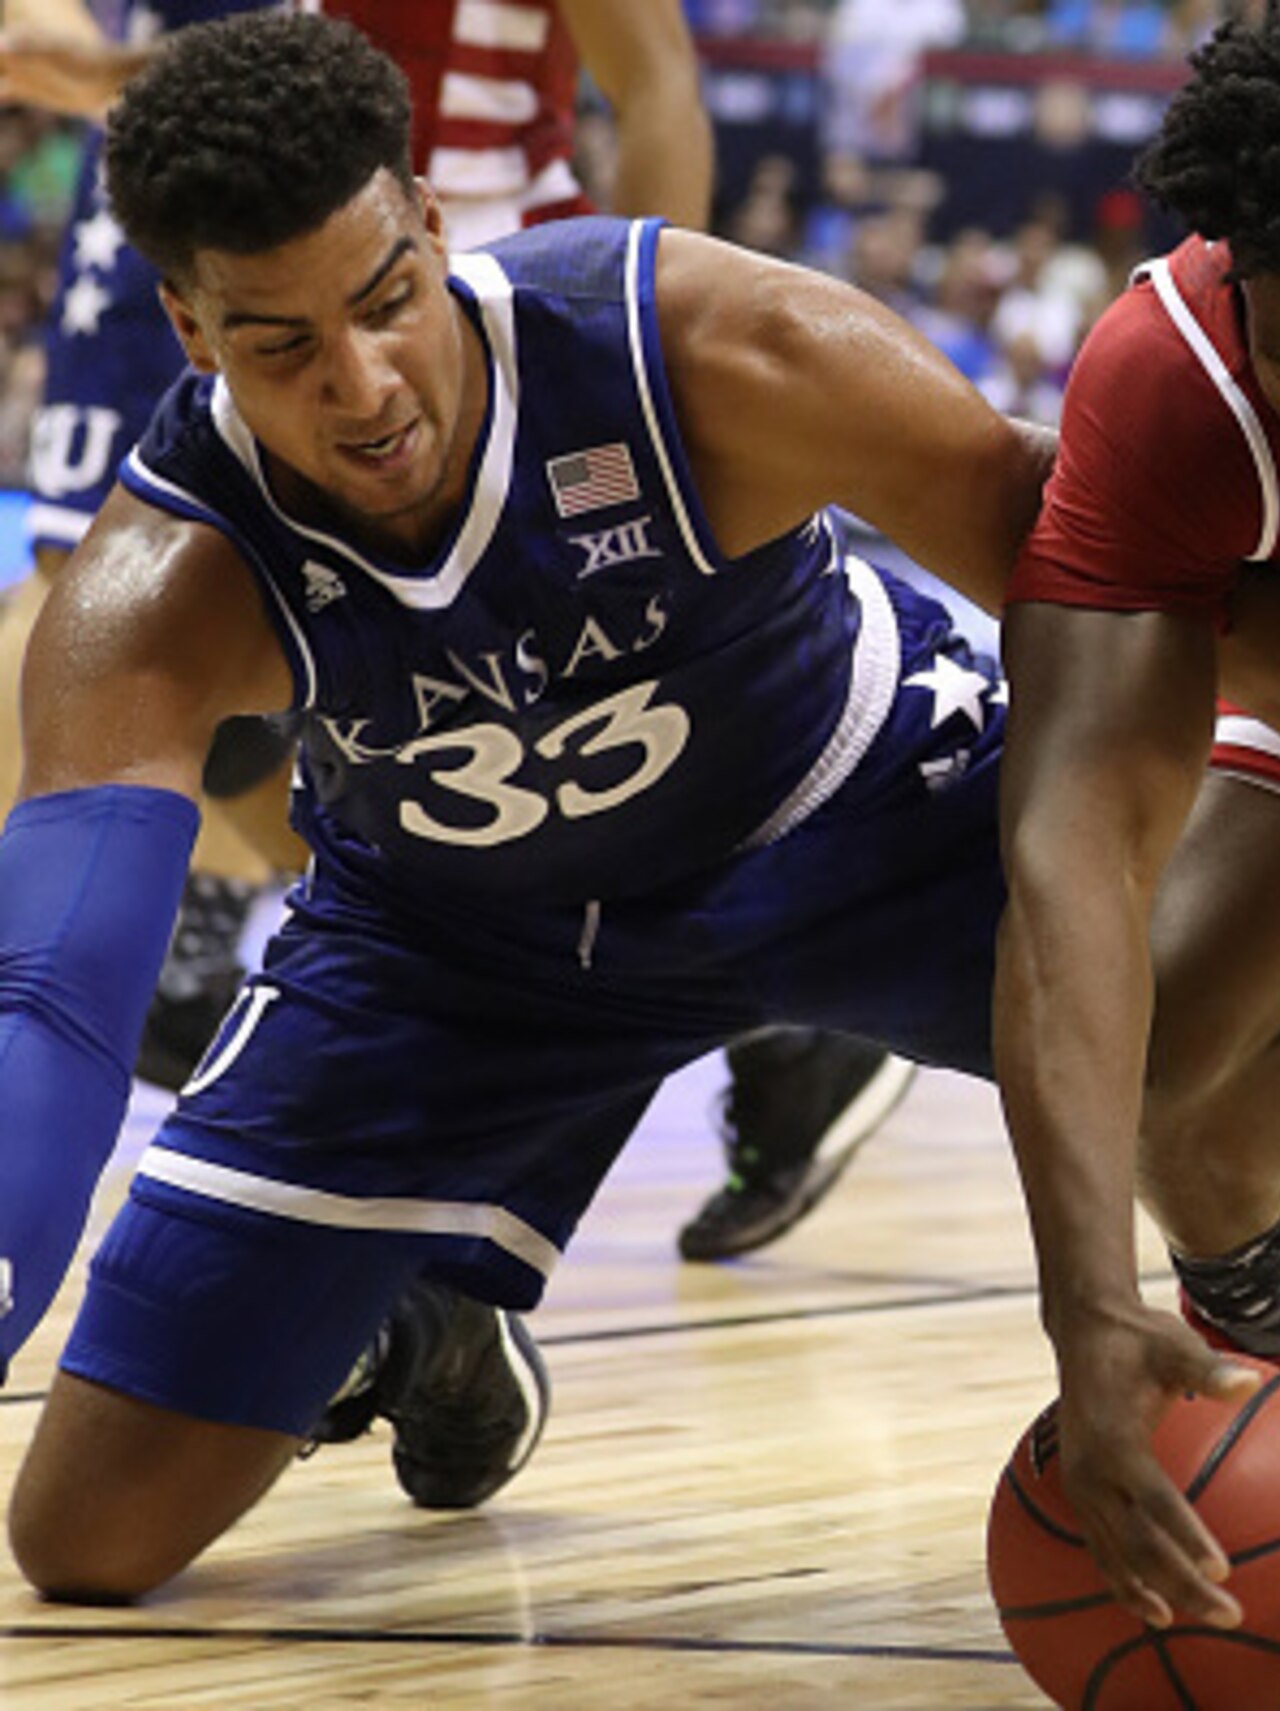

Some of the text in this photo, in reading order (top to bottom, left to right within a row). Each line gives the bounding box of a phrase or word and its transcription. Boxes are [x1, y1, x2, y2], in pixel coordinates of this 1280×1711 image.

[567, 515, 662, 580] XII
[320, 590, 671, 765] KANSAS
[395, 680, 691, 848] 33
